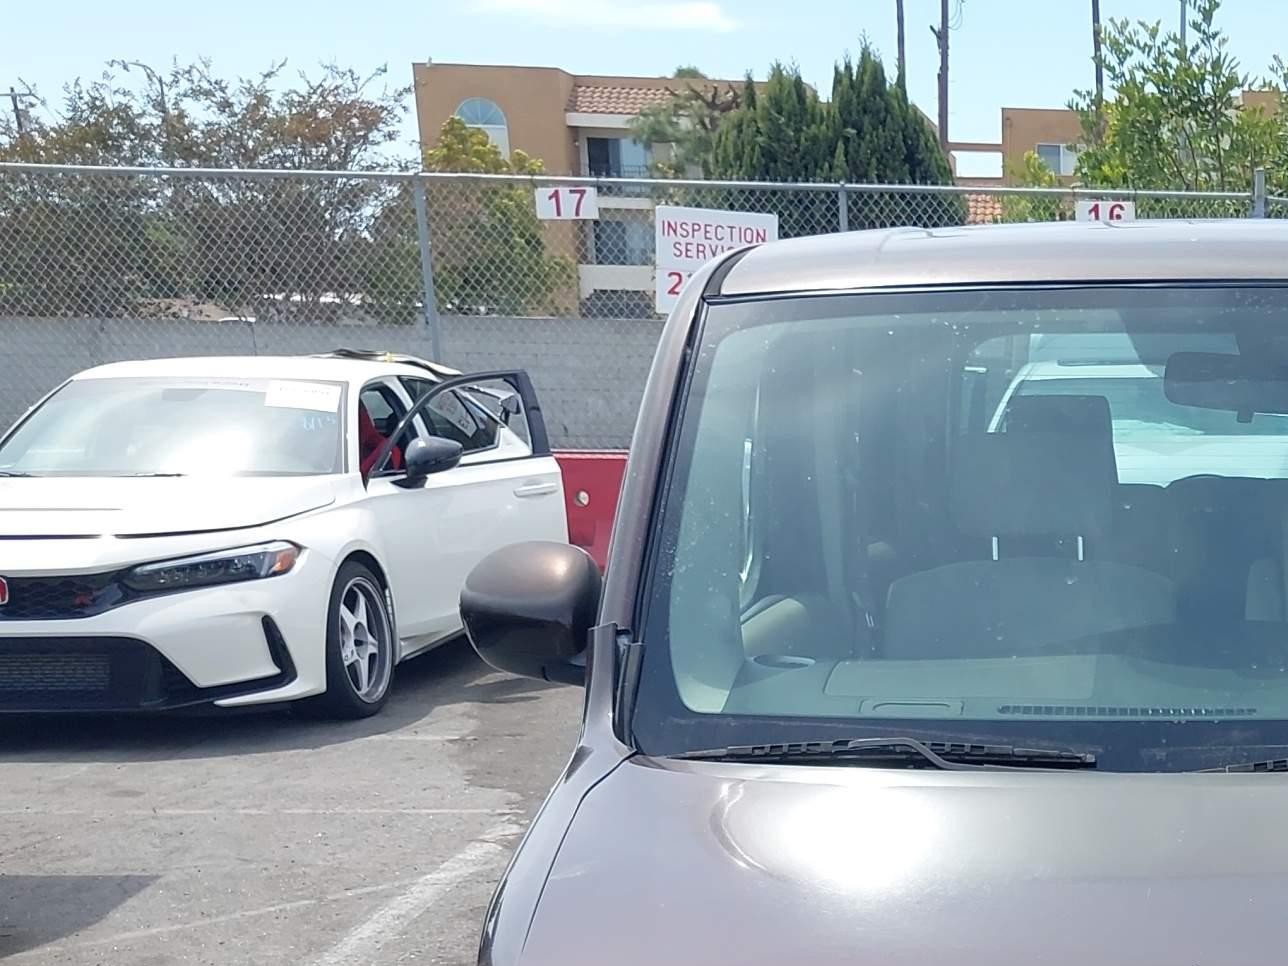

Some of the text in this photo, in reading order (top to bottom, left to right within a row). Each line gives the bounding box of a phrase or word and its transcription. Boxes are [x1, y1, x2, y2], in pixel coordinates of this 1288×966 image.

[547, 189, 587, 217] 17
[1088, 203, 1125, 220] 16
[661, 220, 767, 243] INSPECTION
